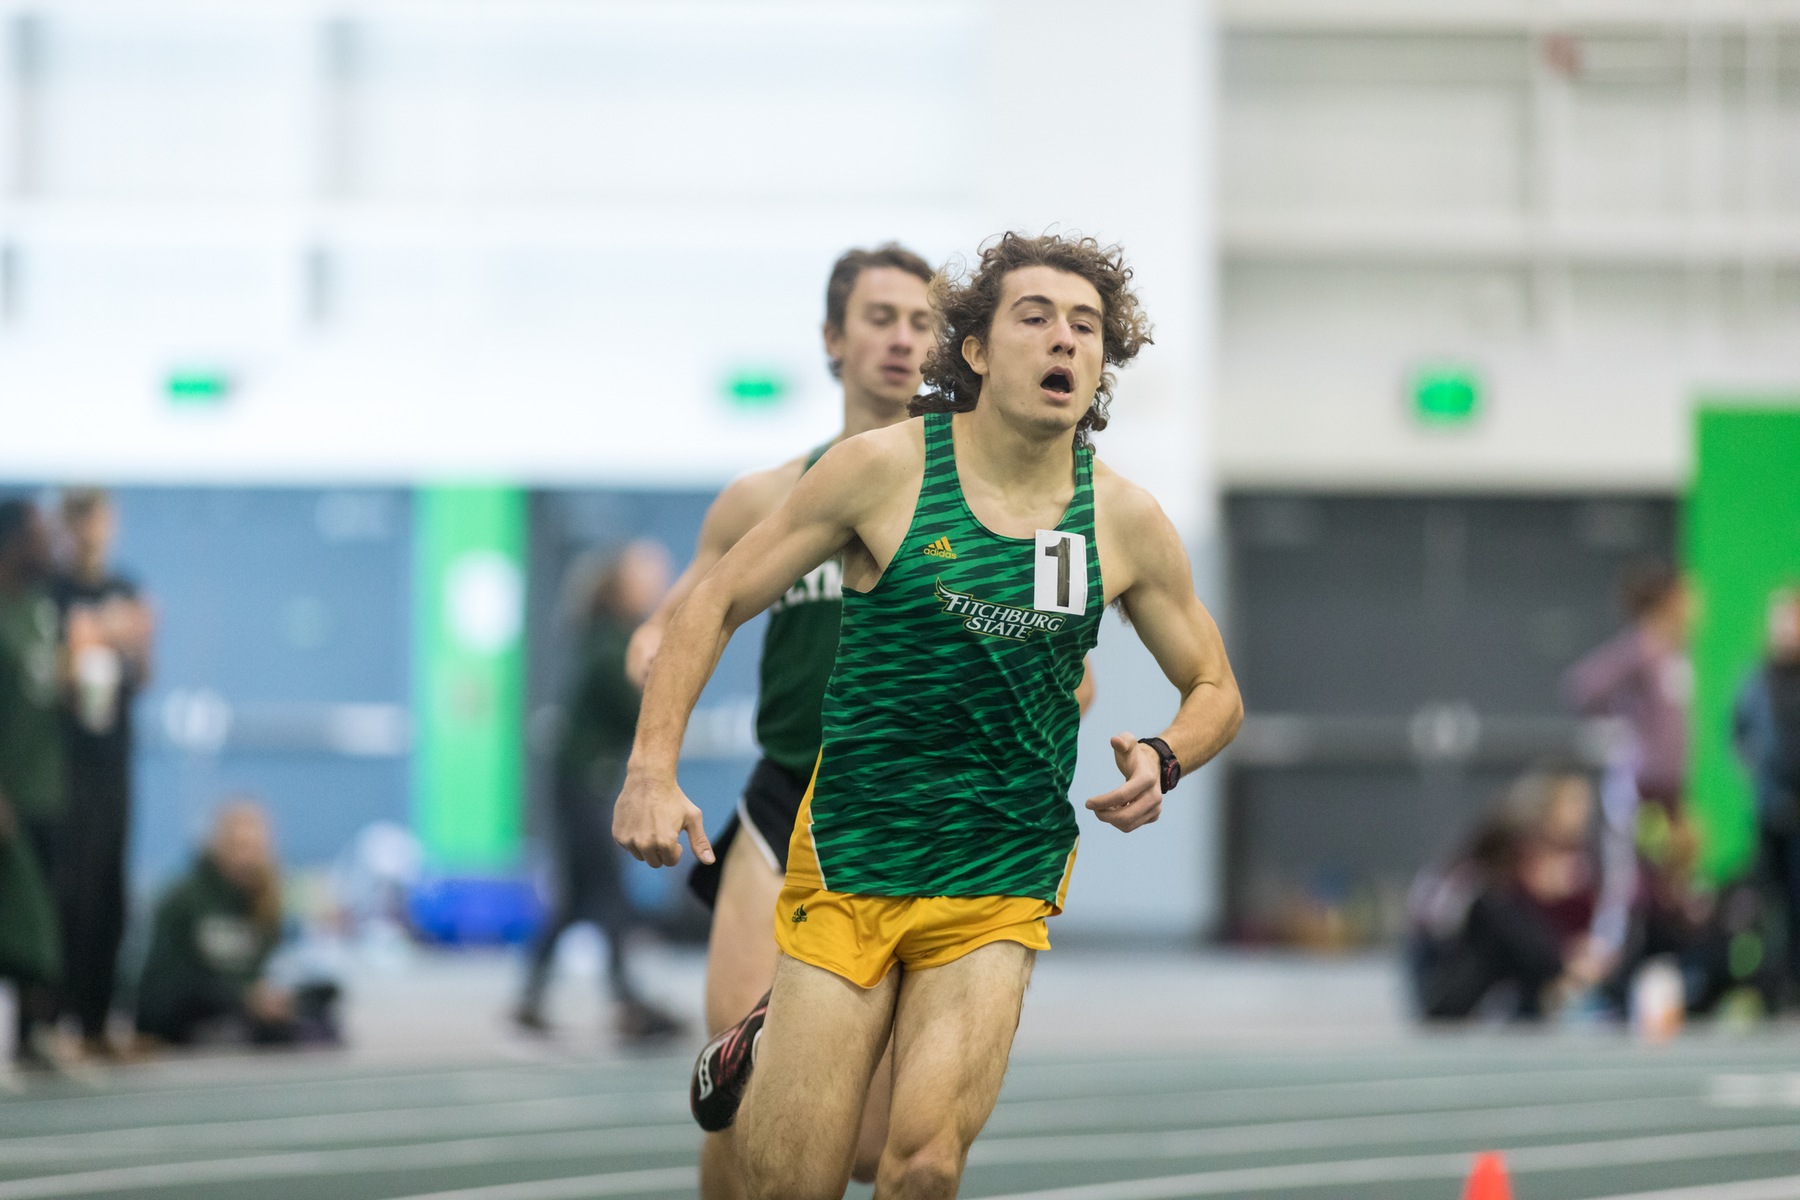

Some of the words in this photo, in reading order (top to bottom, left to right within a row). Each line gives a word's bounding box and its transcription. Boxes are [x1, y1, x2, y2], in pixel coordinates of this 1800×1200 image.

[923, 547, 957, 560] adidas
[1045, 536, 1071, 608] 1
[942, 590, 1063, 632] FITCHBURG
[966, 616, 1032, 639] STATE
